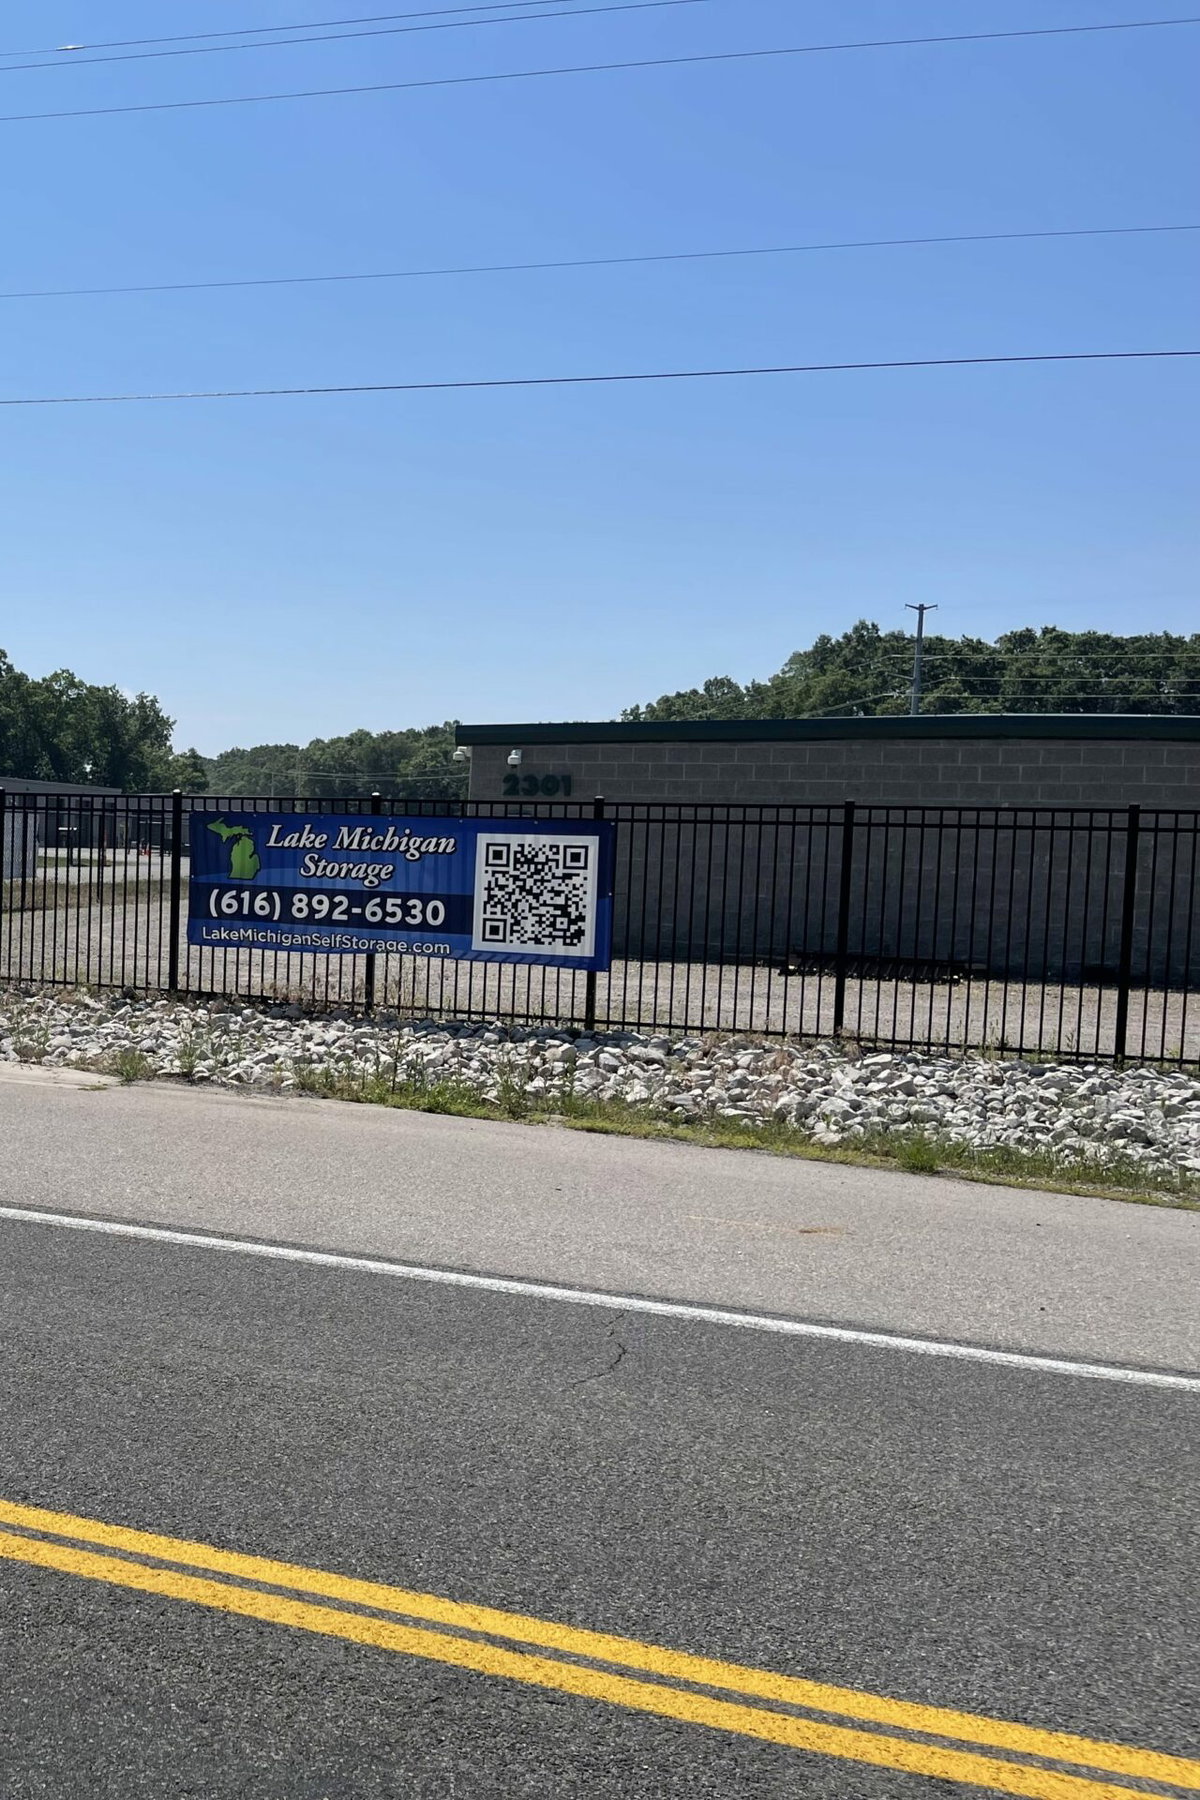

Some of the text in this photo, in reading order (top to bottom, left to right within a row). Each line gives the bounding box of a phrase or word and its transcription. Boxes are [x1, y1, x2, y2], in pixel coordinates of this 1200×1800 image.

[503, 774, 572, 796] 2301
[266, 823, 456, 861] Lake Michigan
[300, 852, 395, 887] Storage
[209, 888, 446, 926] (616) 892-6530
[202, 926, 451, 955] LakeMichiganSelfStorage.com
